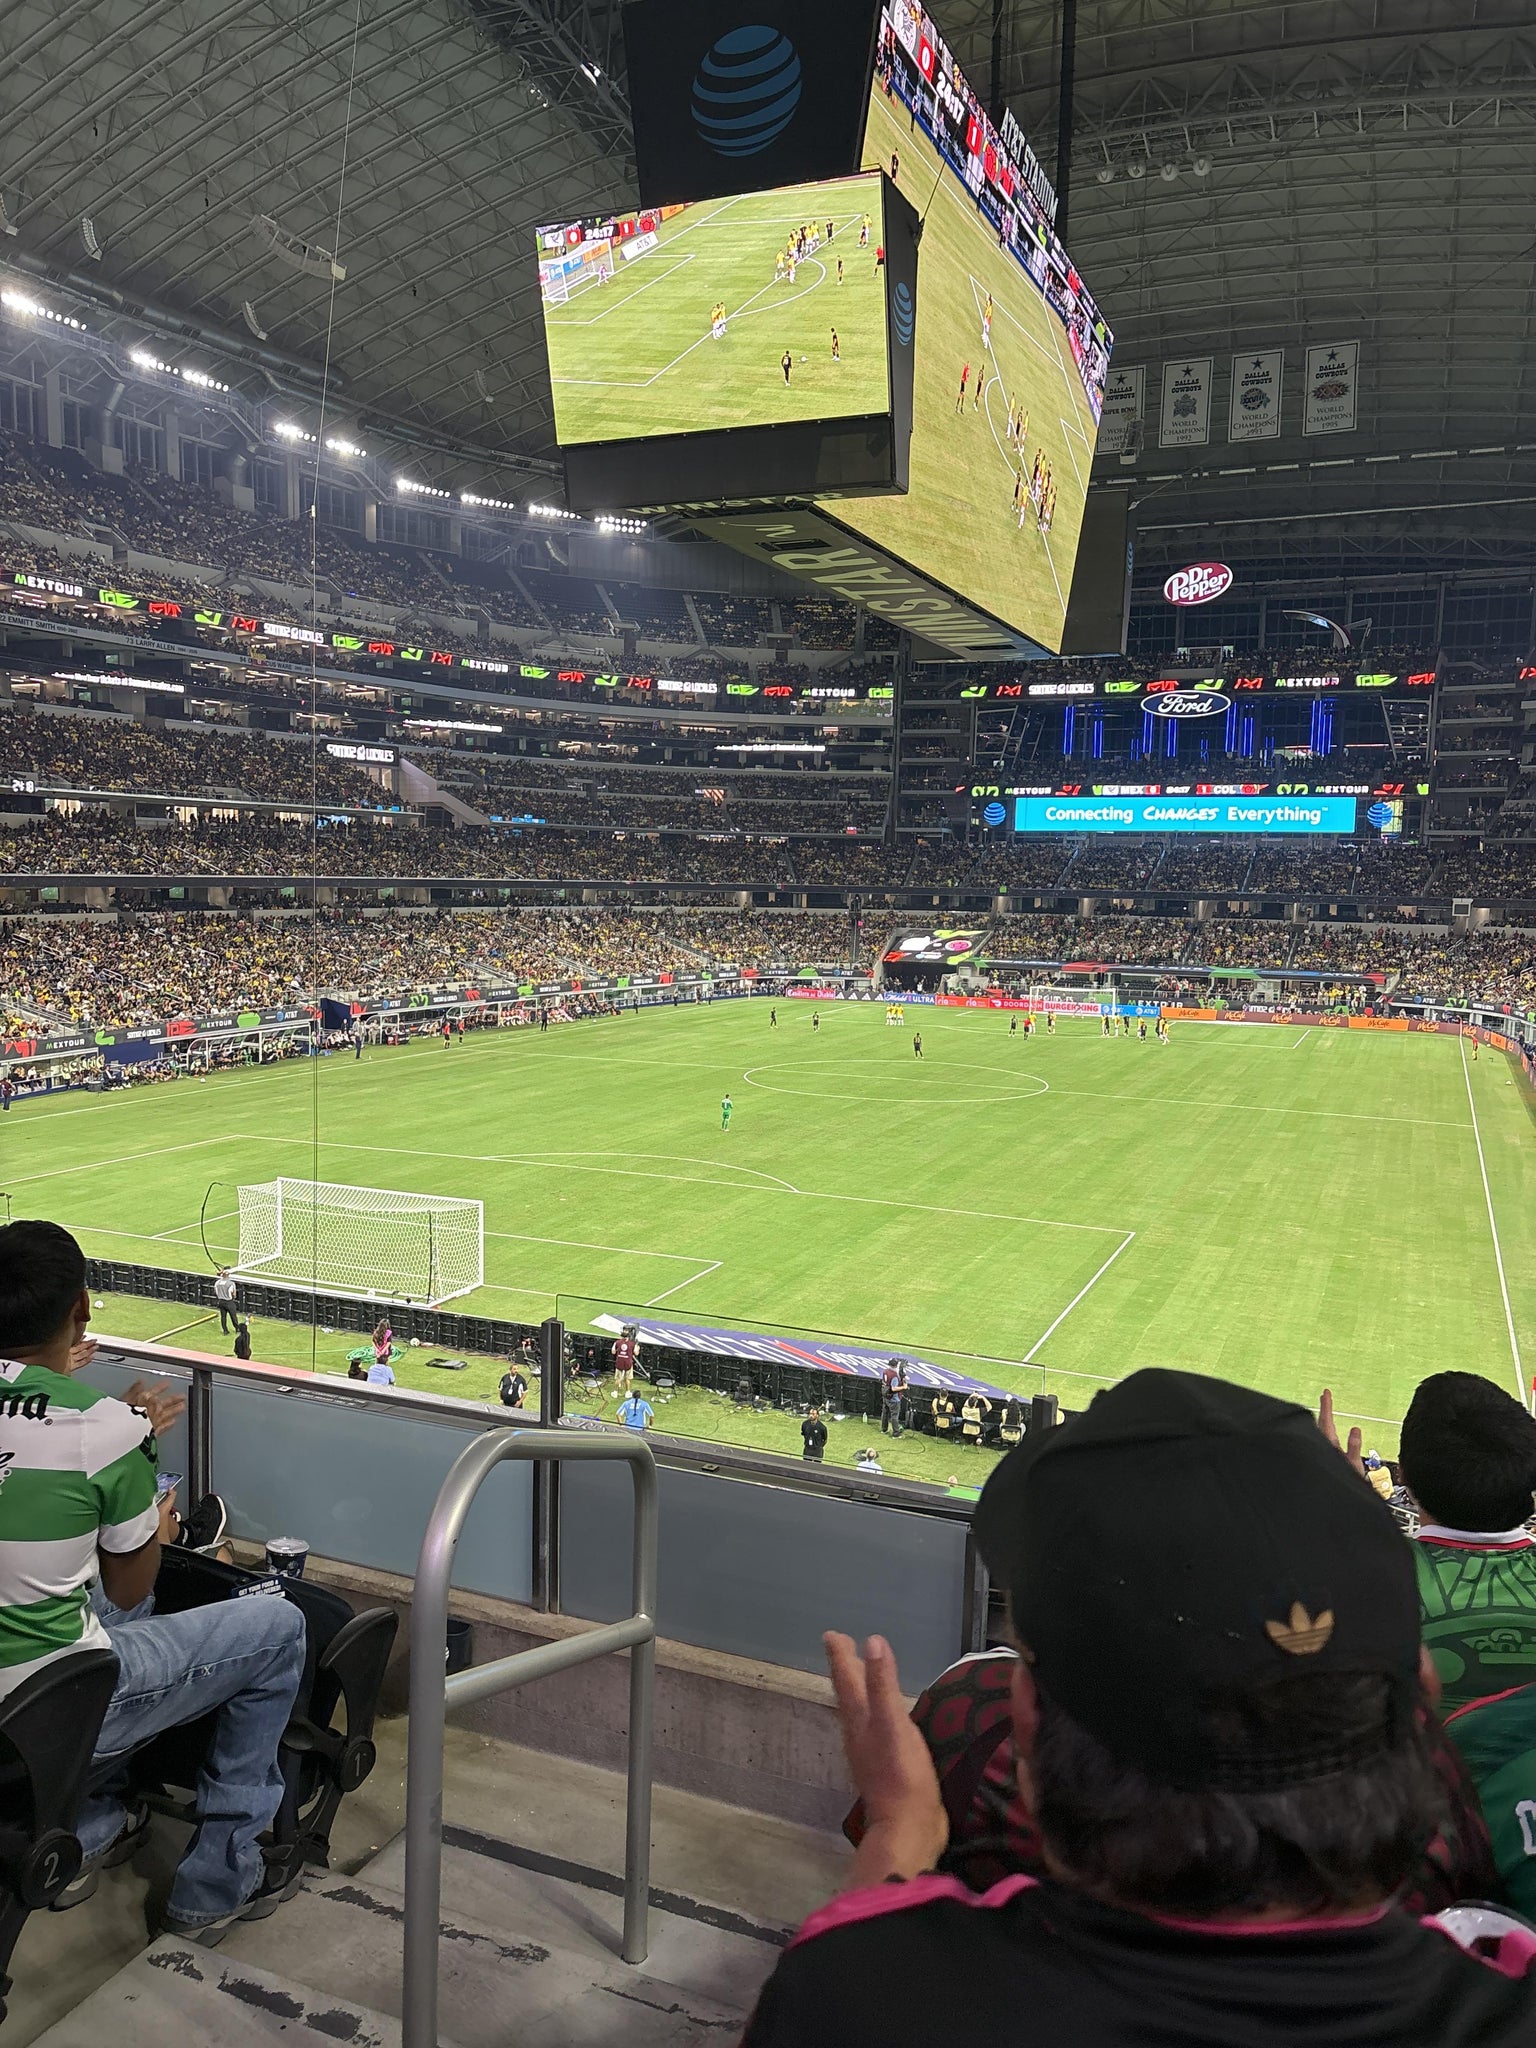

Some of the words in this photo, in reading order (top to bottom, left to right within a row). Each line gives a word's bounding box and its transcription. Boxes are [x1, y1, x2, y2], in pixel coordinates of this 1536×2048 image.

[1001, 106, 1026, 166] AT&T
[1022, 144, 1059, 225] STADIUM
[584, 226, 614, 240] 24:17
[636, 236, 653, 251] AT&T
[1319, 362, 1345, 372] DALLAS
[1244, 371, 1270, 380] DALLAS
[1315, 370, 1348, 380] COWBOYS
[1174, 379, 1200, 387] DALLAS
[1241, 377, 1273, 387] COWBOYS
[1109, 386, 1133, 395] DALLAS
[1171, 385, 1202, 394] COWBOYS
[1106, 393, 1135, 402] COWBOYS
[1102, 408, 1120, 416] SUPER
[1316, 406, 1344, 415] WORLD
[1241, 413, 1269, 421] WORLD
[1307, 413, 1353, 424] CHAMPIONS
[1171, 420, 1198, 428] WORLD
[1233, 421, 1276, 430] CHAMPIONS
[1163, 427, 1205, 436] CHAMPIONS
[626, 492, 844, 515] WINSTAR
[1188, 567, 1214, 586] Dr
[14, 573, 83, 598] MEXTOUR
[1171, 572, 1228, 602] Pepper
[7, 616, 34, 629] EMMITT
[36, 621, 57, 631] SMITH
[135, 639, 156, 650] LARRY
[156, 642, 176, 652] ALLEN
[461, 658, 509, 673] MEXTOUR
[1273, 677, 1340, 689] MEXTOUR
[801, 688, 856, 698] MEXTOUR
[1157, 693, 1214, 714] Ford
[1004, 787, 1052, 796] MEXTOUR
[1120, 785, 1144, 795] MEX
[1213, 785, 1237, 795] COL
[1315, 785, 1369, 794] MEXTOUR
[1045, 806, 1134, 824] Connecting
[1143, 806, 1220, 821] CHANGES
[389, 999, 401, 1008] AT&T
[912, 996, 935, 1004] ULTRA
[1045, 1003, 1076, 1012] BURGER
[1079, 1004, 1099, 1012] KING
[284, 1011, 298, 1020] AT&T
[200, 1019, 232, 1029] MEXTOUR
[45, 1038, 85, 1050] MEXTOUR
[354, 1752, 362, 1777] 1
[43, 1851, 60, 1890] 2
